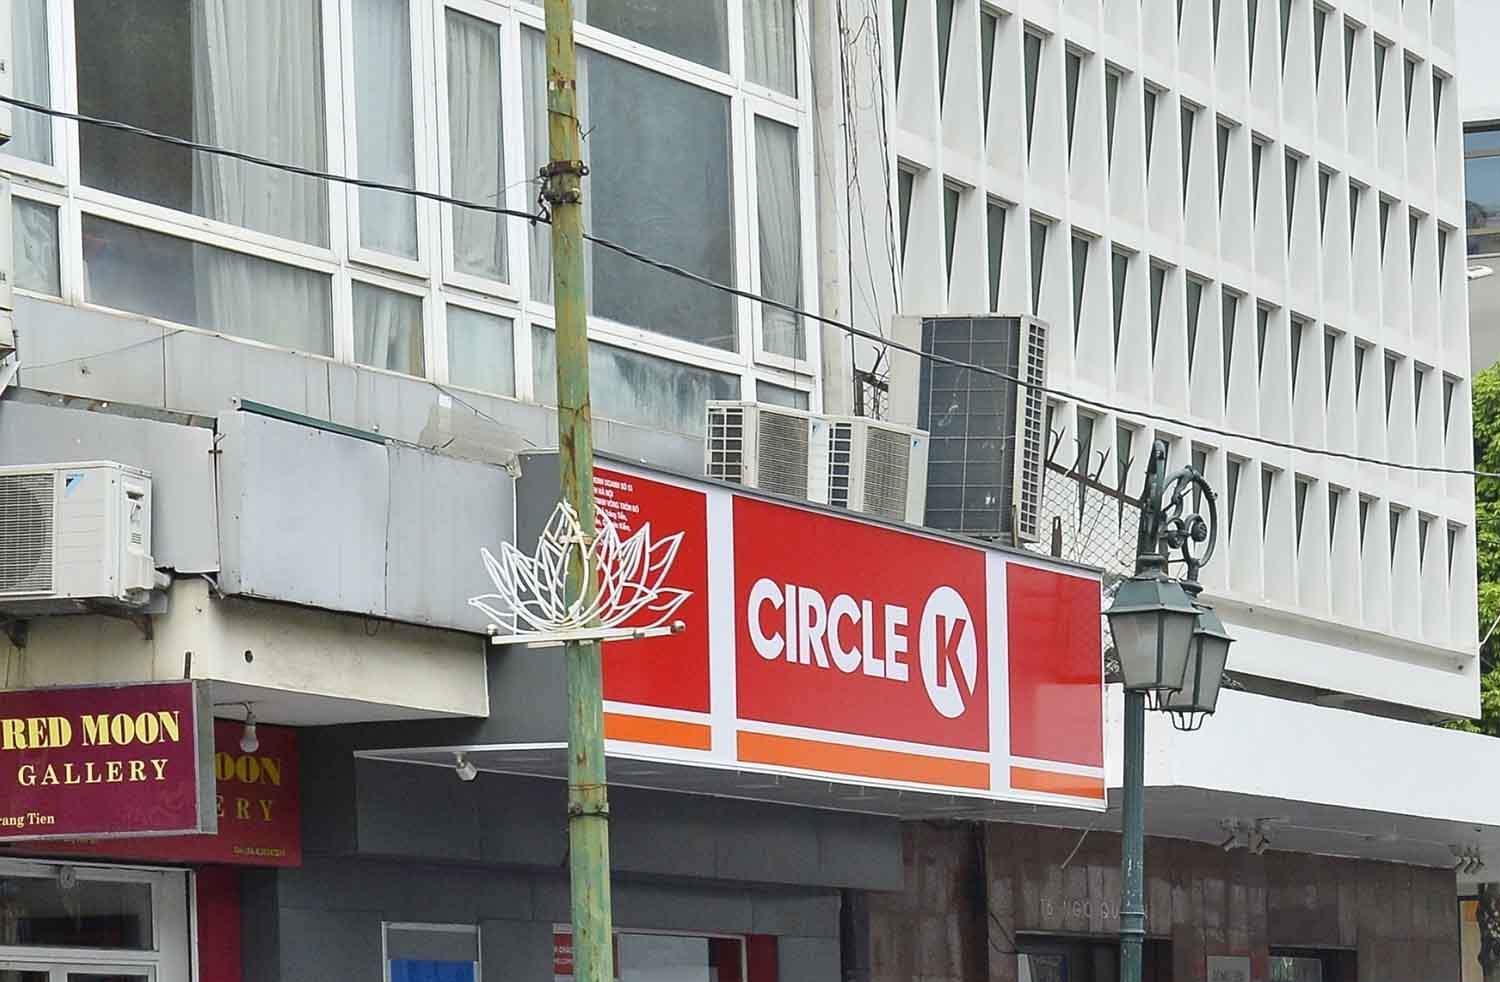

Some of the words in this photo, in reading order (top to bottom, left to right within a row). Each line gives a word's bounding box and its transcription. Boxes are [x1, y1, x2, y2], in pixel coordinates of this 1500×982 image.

[748, 578, 909, 682] CIRCLE
[1, 716, 73, 750] RED
[82, 711, 181, 746] MOON
[18, 759, 169, 786] GALLERY
[215, 752, 282, 786] OON
[27, 812, 55, 824] Tien
